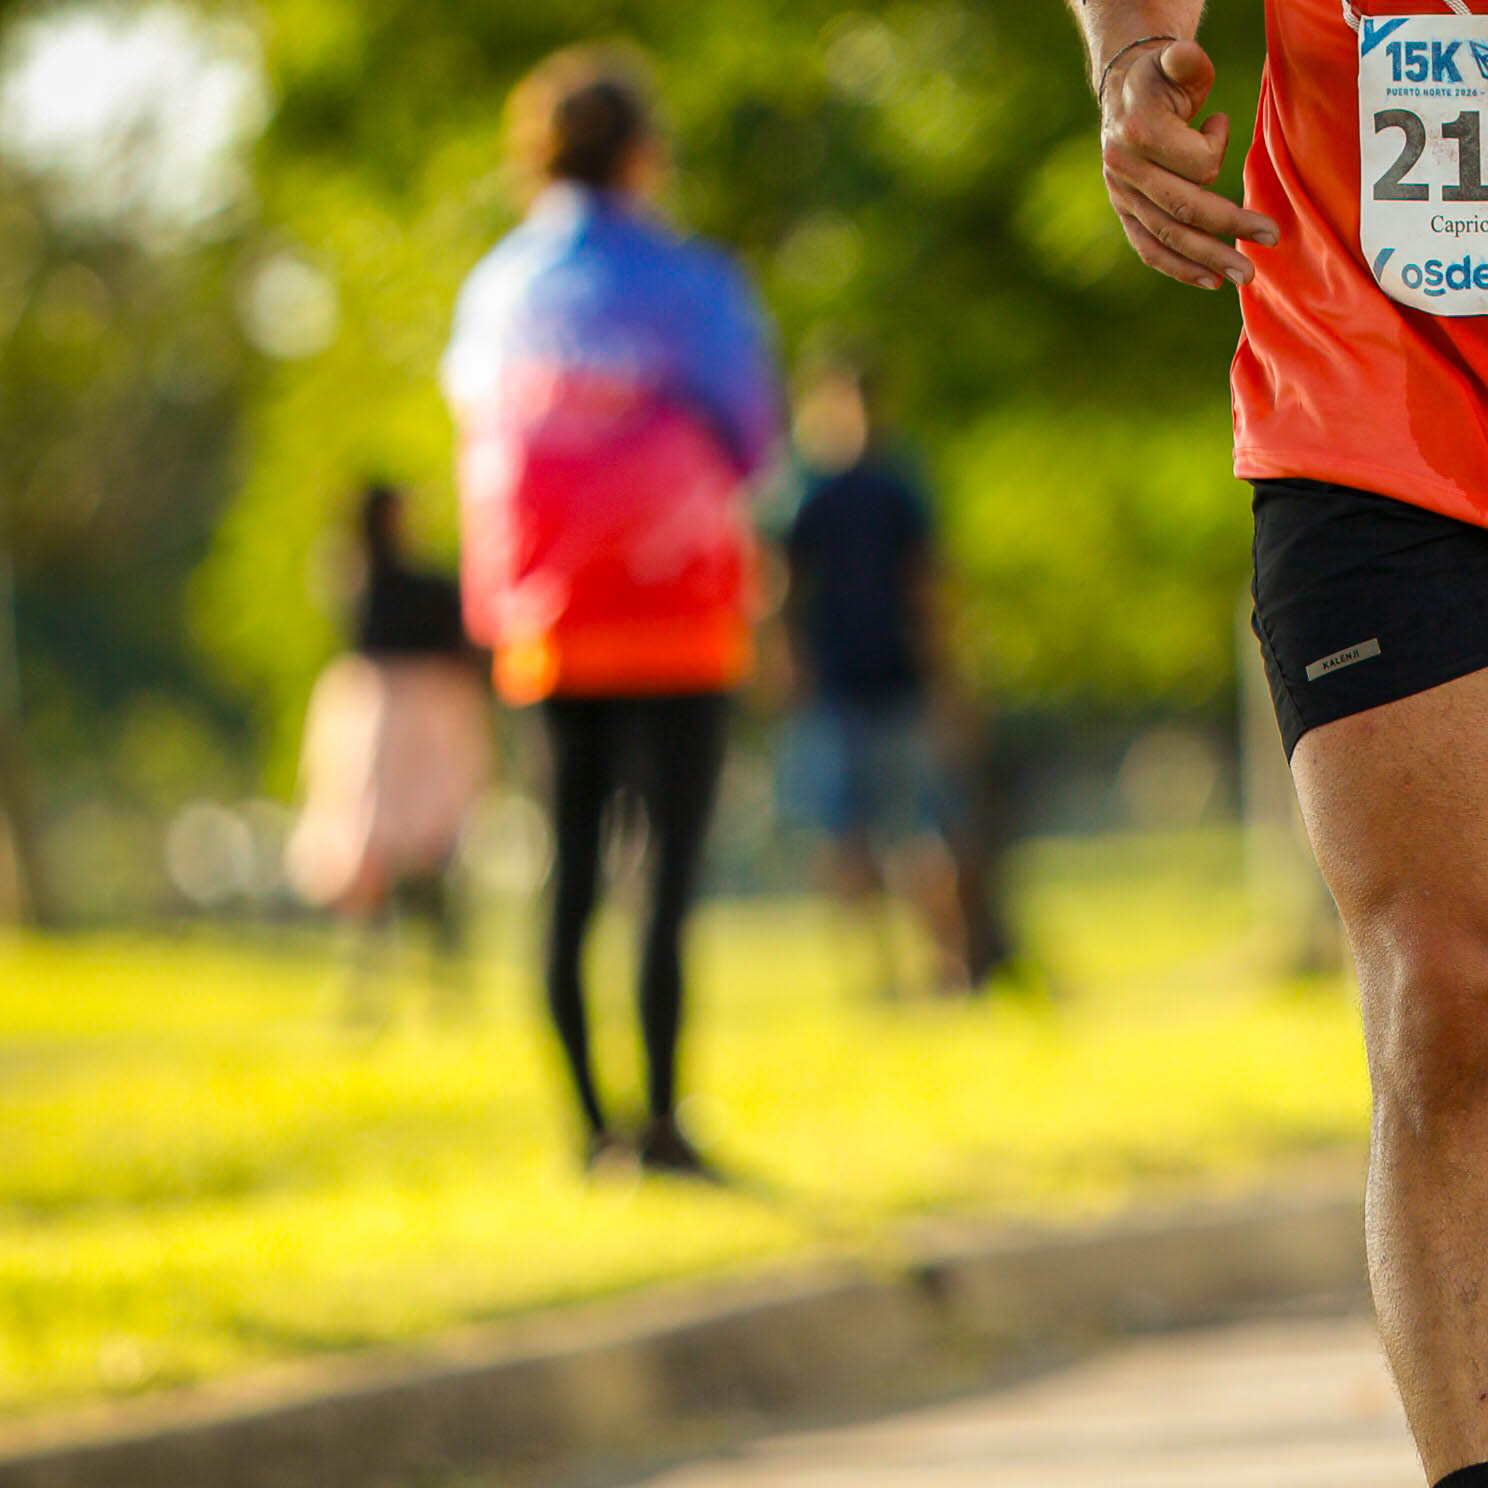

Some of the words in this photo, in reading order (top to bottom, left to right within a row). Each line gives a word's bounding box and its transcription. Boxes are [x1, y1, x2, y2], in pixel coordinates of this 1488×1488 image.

[1386, 41, 1463, 83] 15K
[1386, 87, 1421, 97] PUERTO
[1423, 87, 1452, 97] NORTE
[1455, 87, 1478, 97] 2026
[1322, 650, 1360, 670] KALENJI
